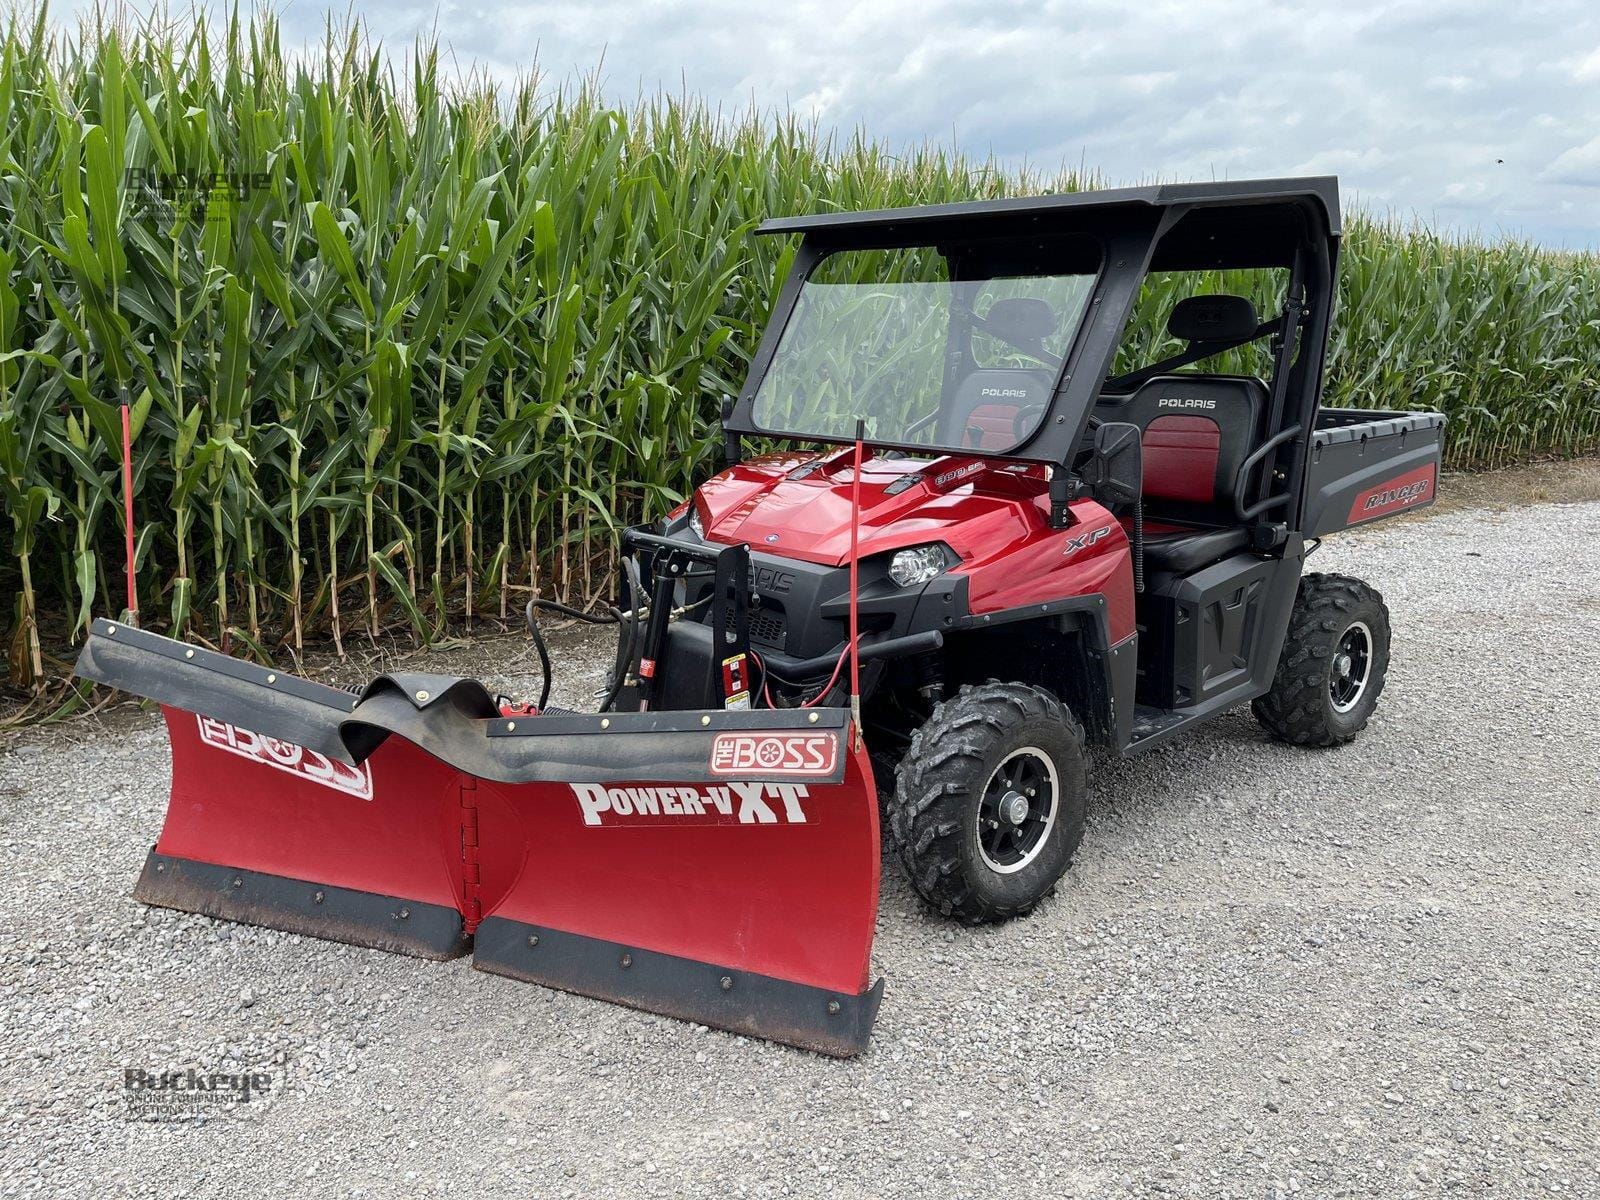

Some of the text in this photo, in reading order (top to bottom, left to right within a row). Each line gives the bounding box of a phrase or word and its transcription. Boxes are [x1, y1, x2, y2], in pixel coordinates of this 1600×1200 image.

[981, 388, 1027, 398] POLARIS
[1158, 398, 1217, 409] POLARIS
[1363, 479, 1429, 511] RANGER
[1062, 525, 1111, 555] XP
[715, 737, 826, 768] THE BOSS
